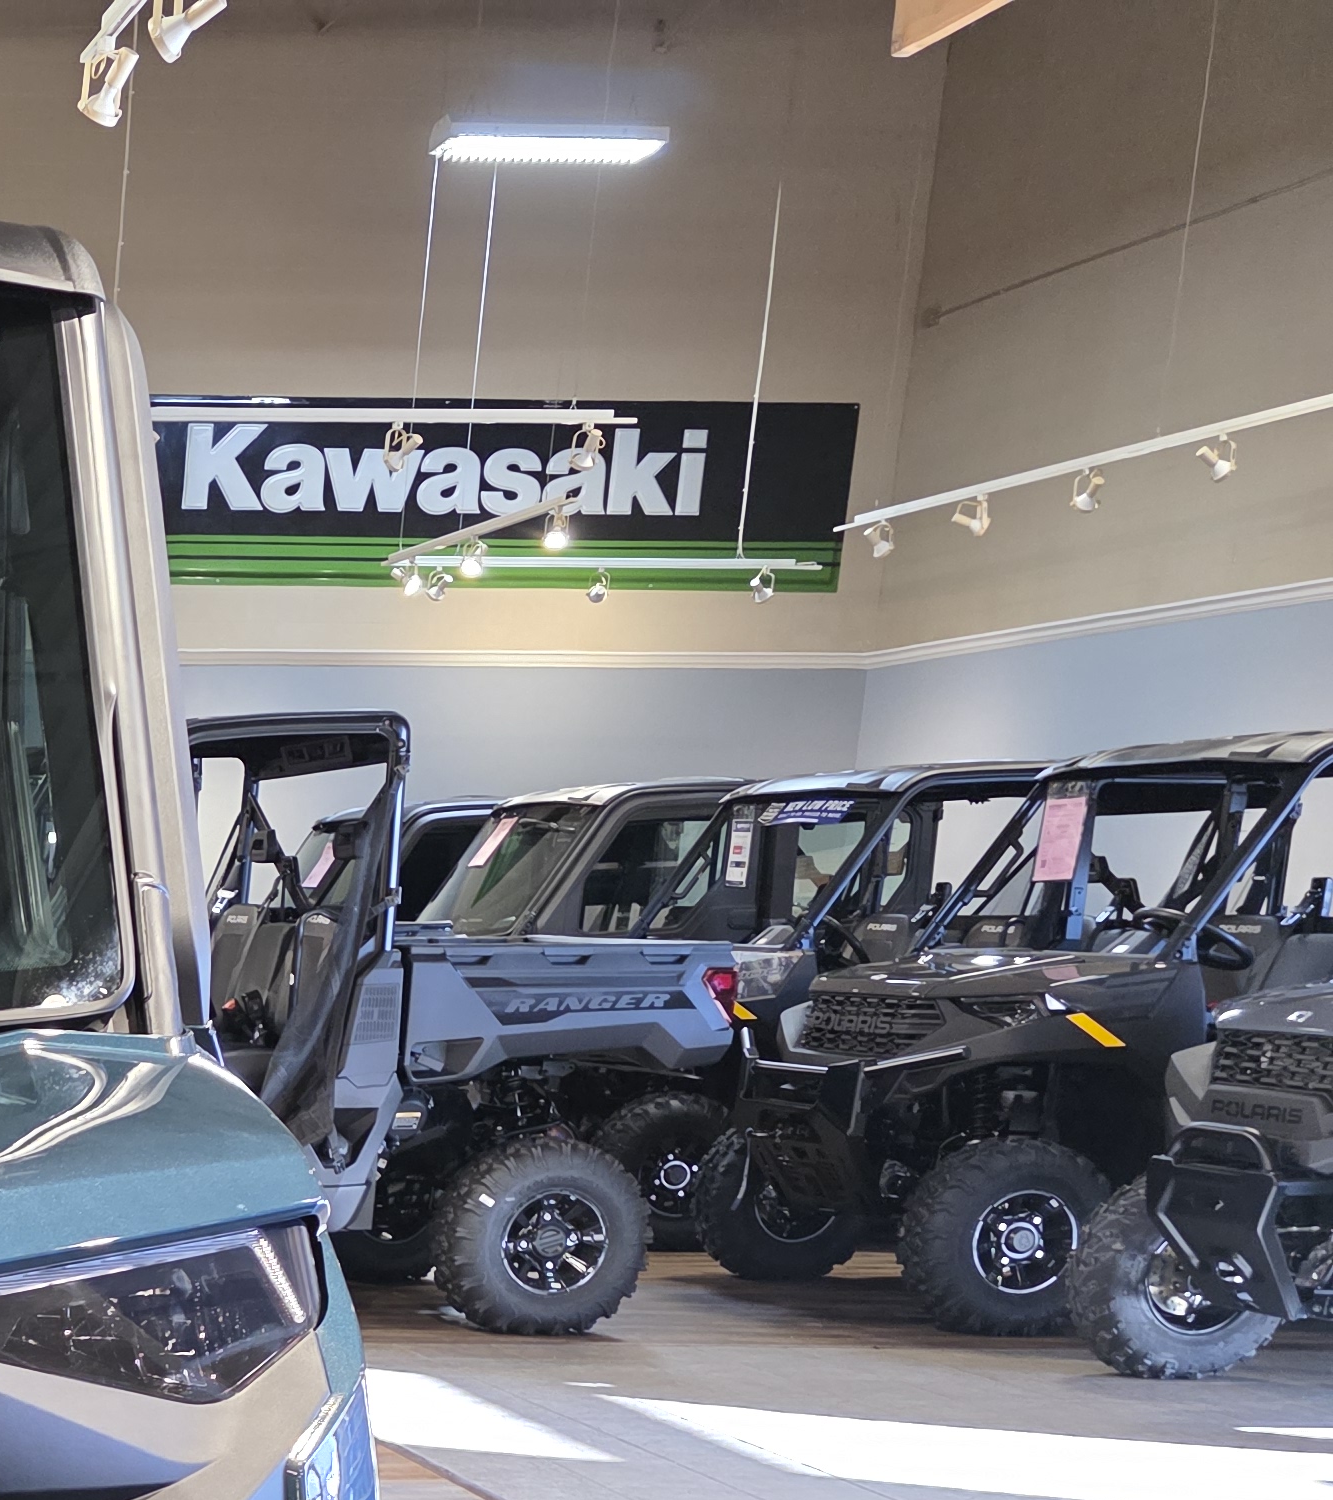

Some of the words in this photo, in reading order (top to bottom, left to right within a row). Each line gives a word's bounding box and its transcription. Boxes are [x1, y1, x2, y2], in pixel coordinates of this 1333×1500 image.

[181, 422, 710, 517] Kawasaki
[822, 800, 855, 812] PRICE
[866, 923, 898, 932] POLARIS
[505, 992, 672, 1013] RANGER
[808, 1011, 891, 1034] POLARIS
[1210, 1098, 1303, 1124] POLARIS
